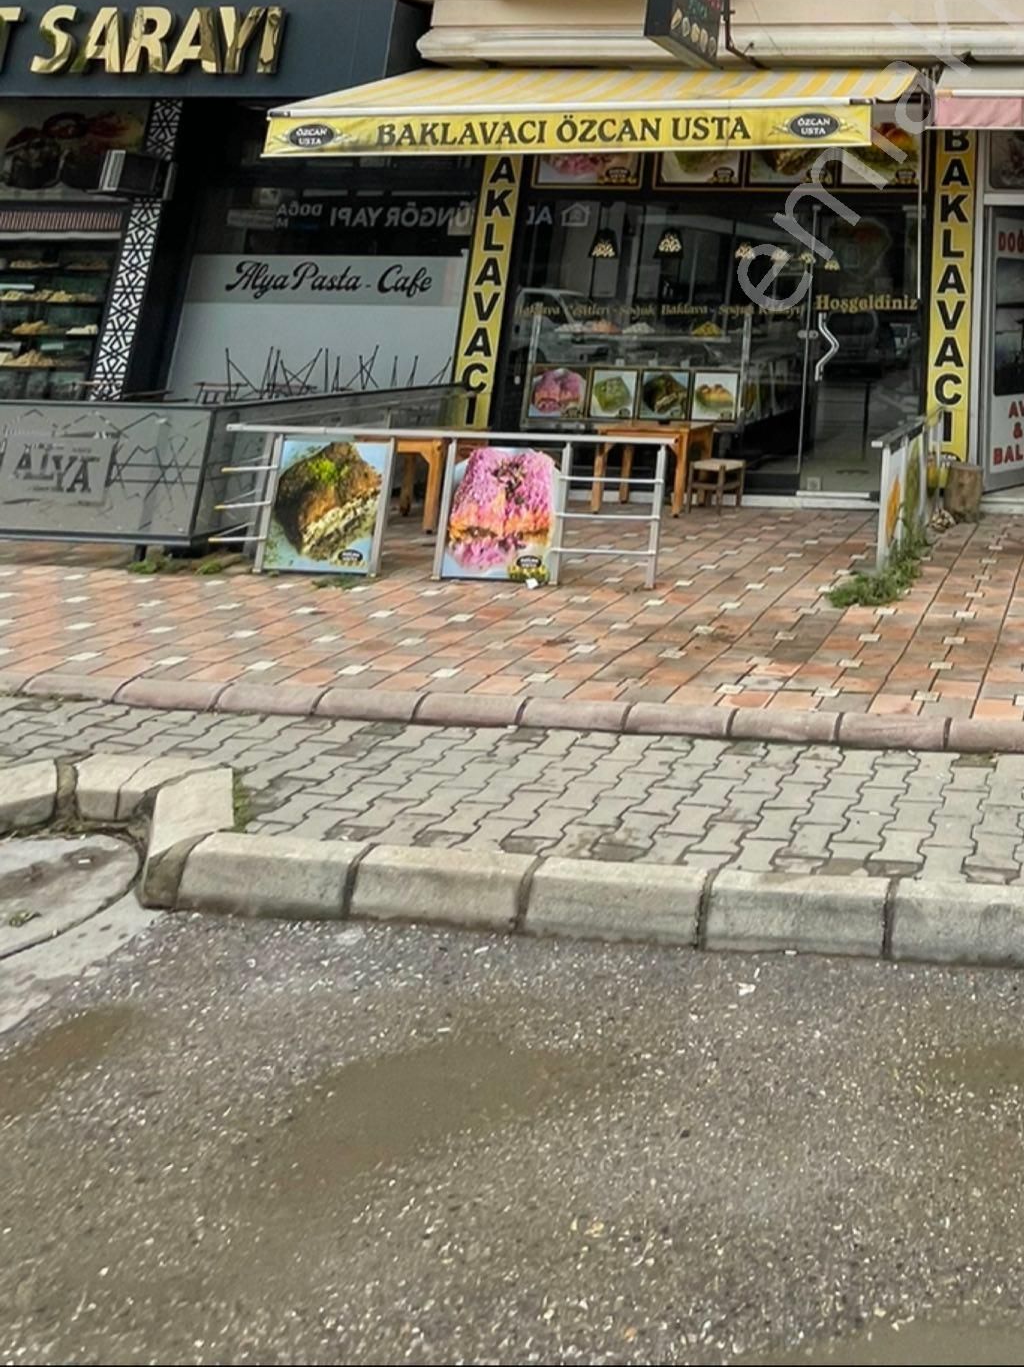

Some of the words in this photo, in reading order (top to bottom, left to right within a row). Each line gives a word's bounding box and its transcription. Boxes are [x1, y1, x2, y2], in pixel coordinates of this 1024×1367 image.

[30, 4, 284, 75] SARAYI
[375, 119, 548, 147] BAKLAVACI
[556, 114, 662, 143] ÖZCAN
[671, 116, 752, 141] USTA
[796, 115, 831, 127] ÖZCAN
[800, 127, 827, 137] USTA
[225, 260, 290, 299] Alya
[291, 261, 362, 293] Pasta
[377, 264, 433, 299] Cafe
[462, 156, 516, 426] AKLAVACI
